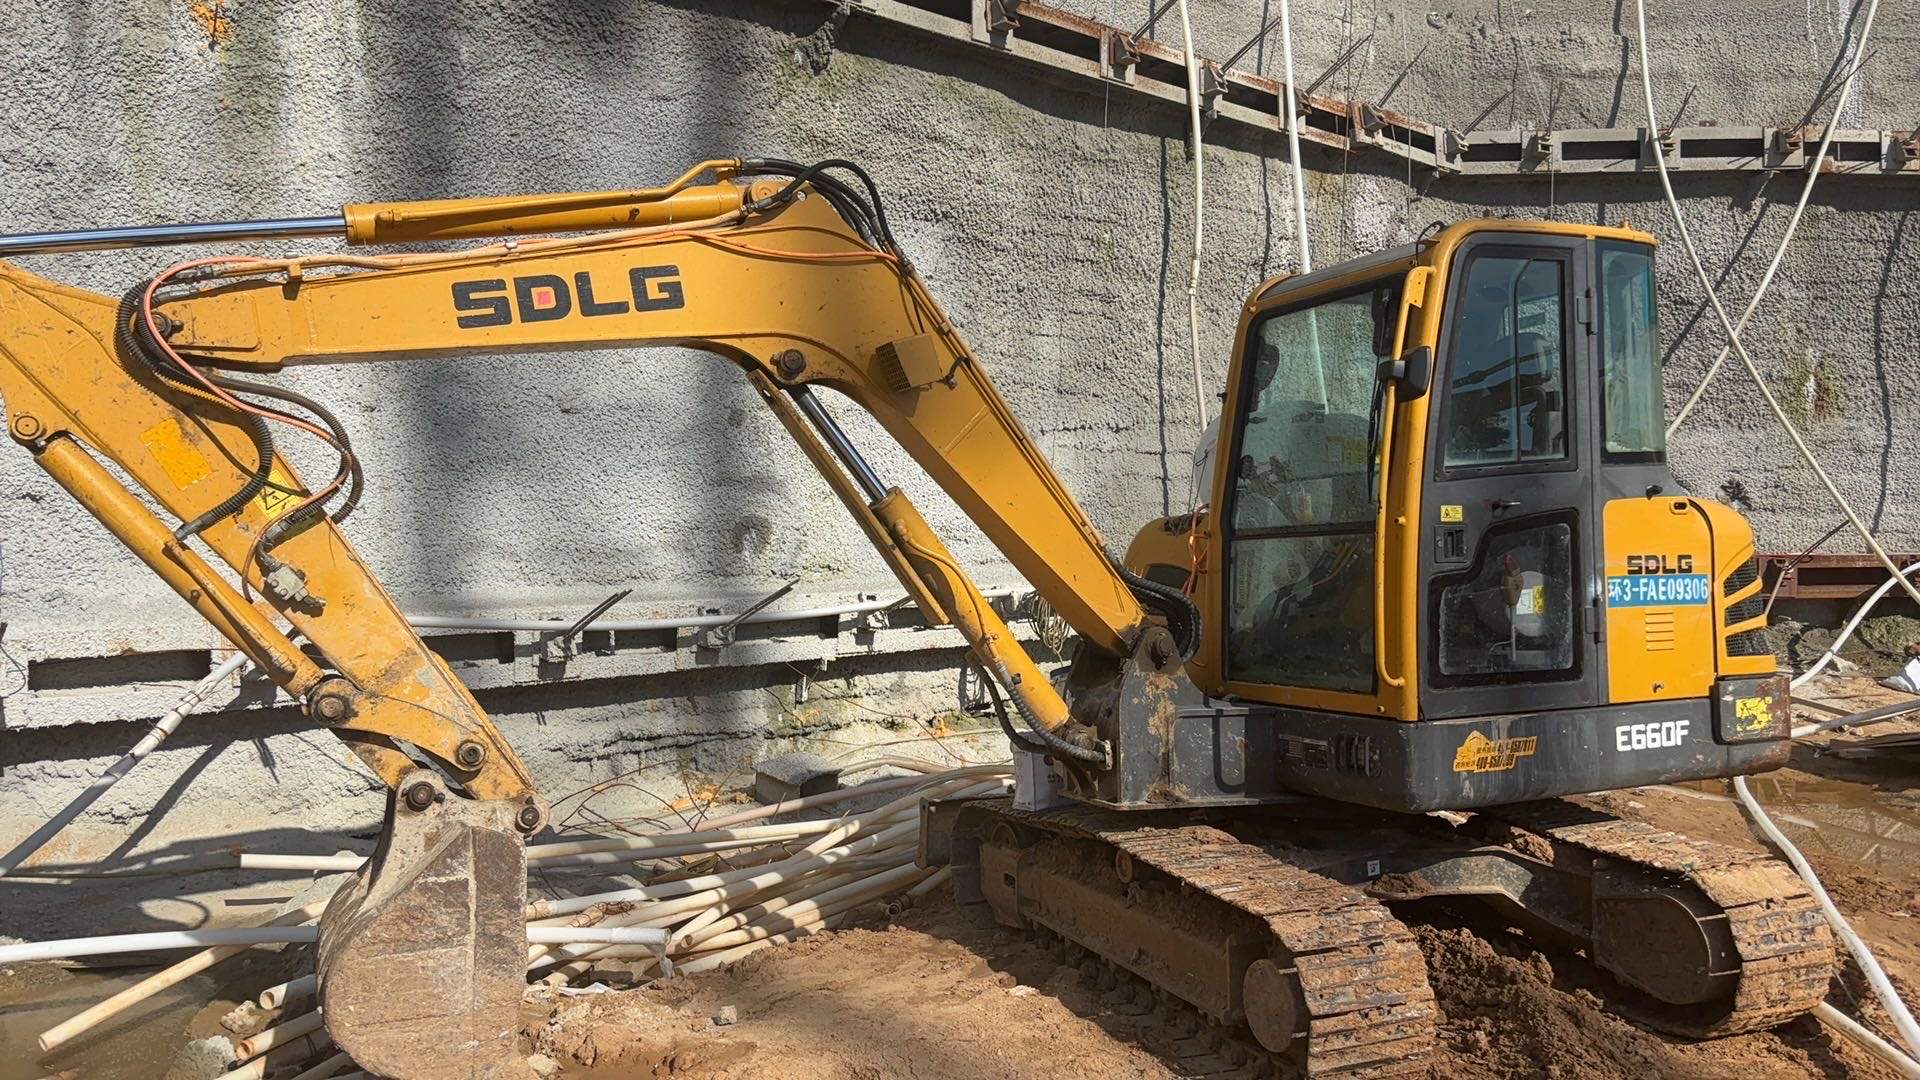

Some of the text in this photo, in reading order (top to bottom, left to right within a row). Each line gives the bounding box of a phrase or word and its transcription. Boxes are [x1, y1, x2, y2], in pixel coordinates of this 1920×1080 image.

[452, 265, 685, 328] SDLG
[1627, 554, 1692, 575] SDLG
[1607, 578, 1708, 602] 环3-FAE09306
[1615, 720, 1690, 752] E660F
